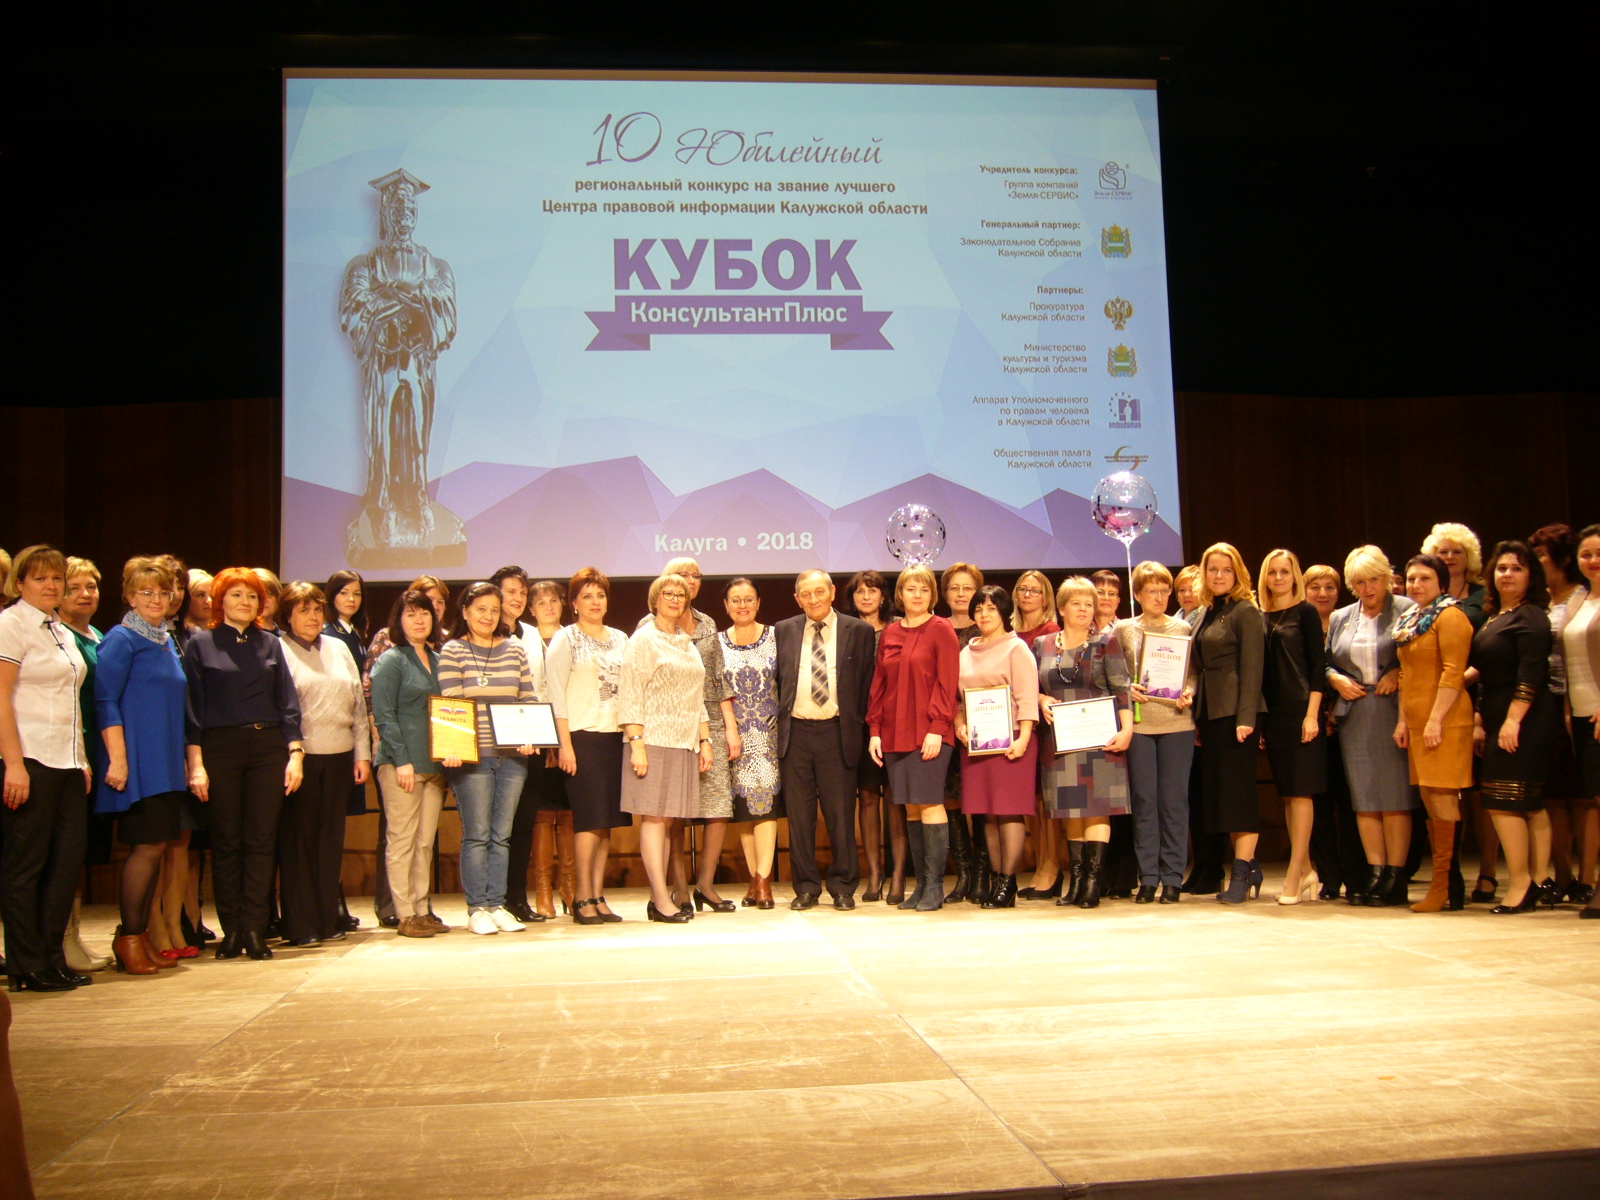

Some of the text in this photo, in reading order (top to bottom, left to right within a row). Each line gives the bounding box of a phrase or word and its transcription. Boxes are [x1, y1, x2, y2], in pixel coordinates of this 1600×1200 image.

[586, 111, 884, 166] 10 Юбилейный
[979, 164, 1078, 176] Учредитель конкурса:
[574, 178, 896, 195] региональный конкурс на звание лучшего
[1003, 179, 1079, 190] Группа компаний
[1007, 190, 1079, 200] «Земля-СЕРВИС»
[542, 199, 928, 217] Центра правовой информации Калужской области
[980, 219, 1081, 231] Генеральный партнер:
[960, 237, 1082, 248] Законодательное Собрание
[997, 248, 1082, 259] Калужской области
[613, 238, 863, 291] КУБОК
[1036, 285, 1084, 296] Партнеры:
[1029, 301, 1085, 312] Прокуратура
[630, 301, 848, 328] КонсультантПлюс
[1001, 312, 1086, 323] Калужской области
[1023, 343, 1087, 353] Министерство
[1002, 355, 1041, 365] культуры
[1051, 356, 1087, 365] туризма
[1003, 364, 1088, 375] Калужской области
[972, 395, 1089, 406] Аппарат Уполномоченного
[999, 406, 1090, 417] по правам человека
[1005, 417, 1053, 428] Калужской
[1055, 416, 1090, 426] области
[993, 448, 1092, 459] Общественная палата
[1007, 458, 1092, 470] Калужской области
[654, 532, 814, 556] Калуга 2018
